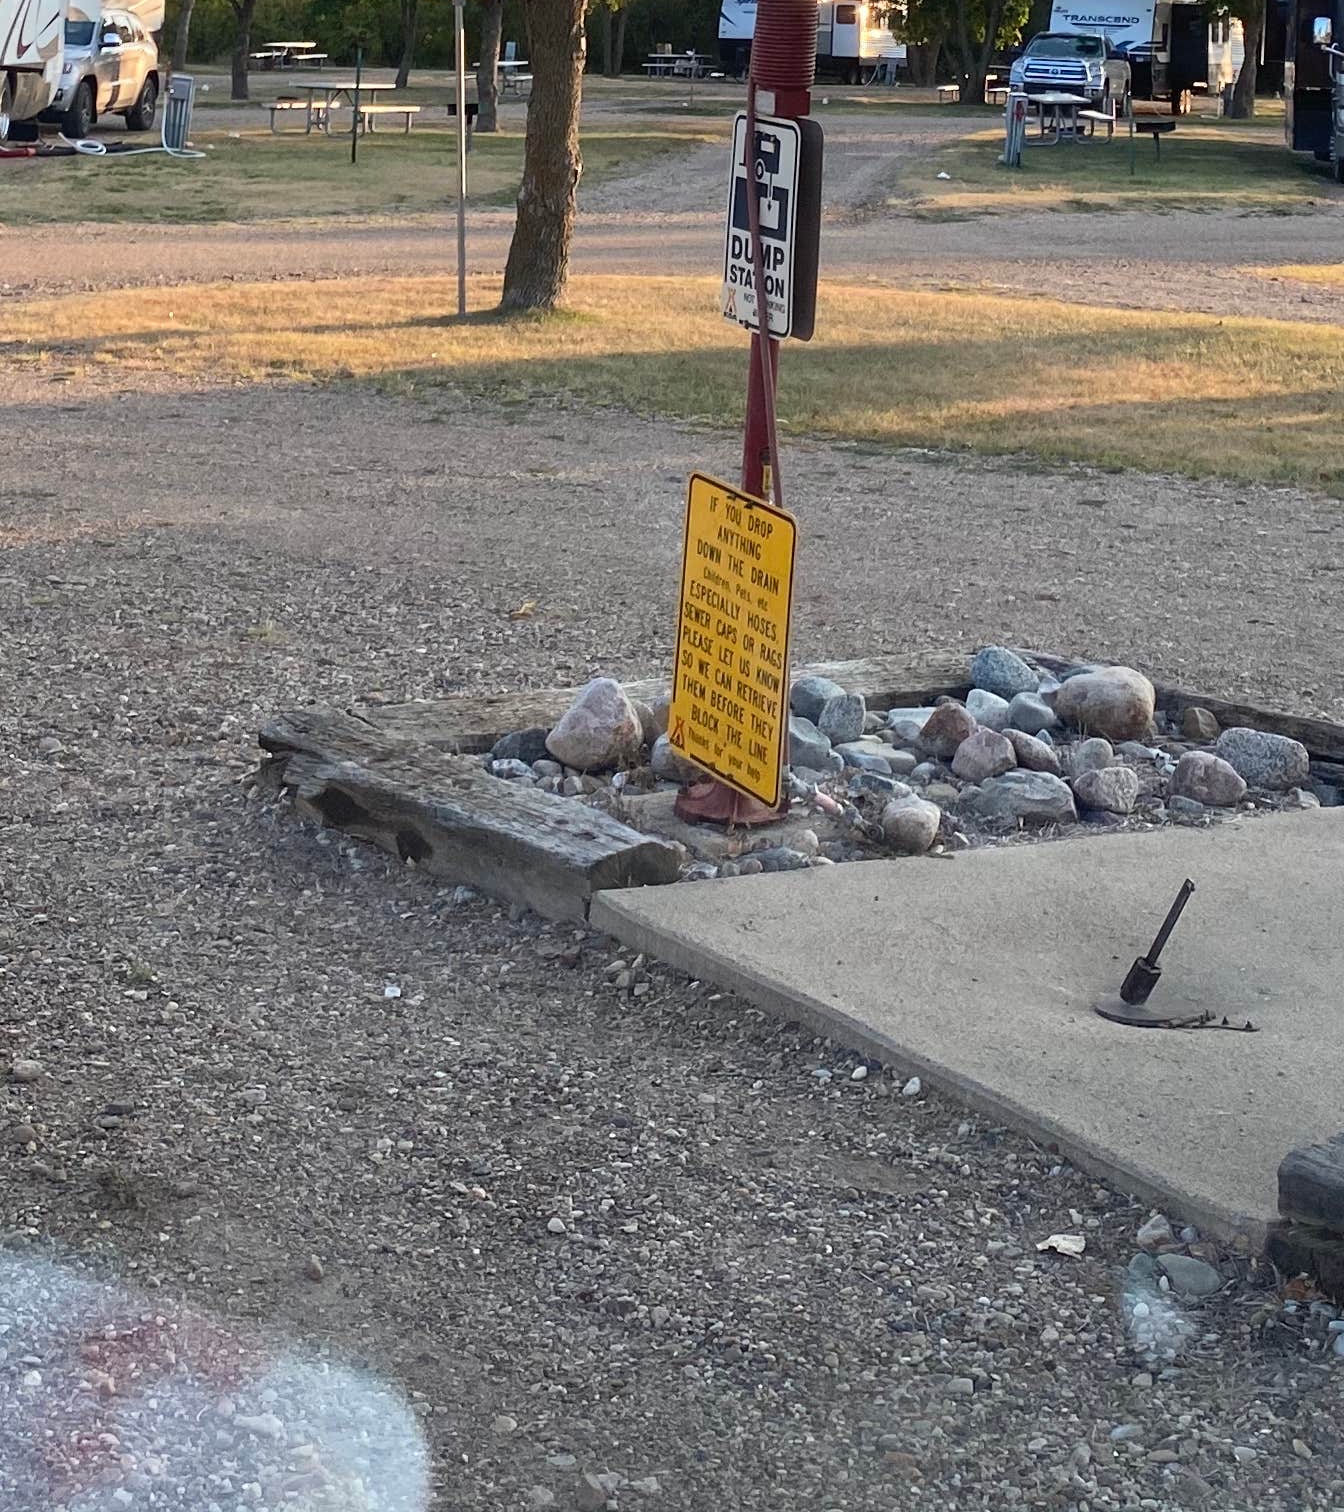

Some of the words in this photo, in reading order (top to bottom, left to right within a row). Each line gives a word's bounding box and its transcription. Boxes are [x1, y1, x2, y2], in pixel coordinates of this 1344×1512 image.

[1063, 14, 1140, 24] TRANSCEND
[731, 234, 785, 271] DUMP
[729, 264, 785, 299] STAON
[743, 292, 756, 304] NOT
[709, 495, 719, 513] IF
[725, 503, 742, 526] YOU
[747, 514, 773, 540] DROP
[717, 524, 762, 561] ANYTHING
[696, 538, 722, 564] DOWN
[728, 553, 744, 578] THE
[750, 566, 780, 596] DRAIN
[690, 580, 741, 621] ESPECIALLY
[683, 601, 711, 630] SEWER
[716, 619, 737, 645] CAPS
[742, 634, 755, 654] OR
[760, 643, 782, 670] RAGS
[682, 625, 714, 656] PLEASE
[718, 645, 734, 668] LET
[739, 656, 750, 677] US
[756, 666, 780, 694] KNOW
[681, 649, 693, 668] SO
[698, 658, 711, 680] WE
[715, 668, 732, 692] CAN
[736, 680, 778, 719] RETRIEVE
[682, 673, 706, 702] THEM
[710, 690, 745, 725] BEFORE
[750, 713, 774, 742] THEY
[691, 704, 719, 735] BLOCK
[726, 724, 742, 749] THE
[748, 738, 768, 765] LINE
[714, 742, 724, 759] for
[728, 753, 744, 770] your
